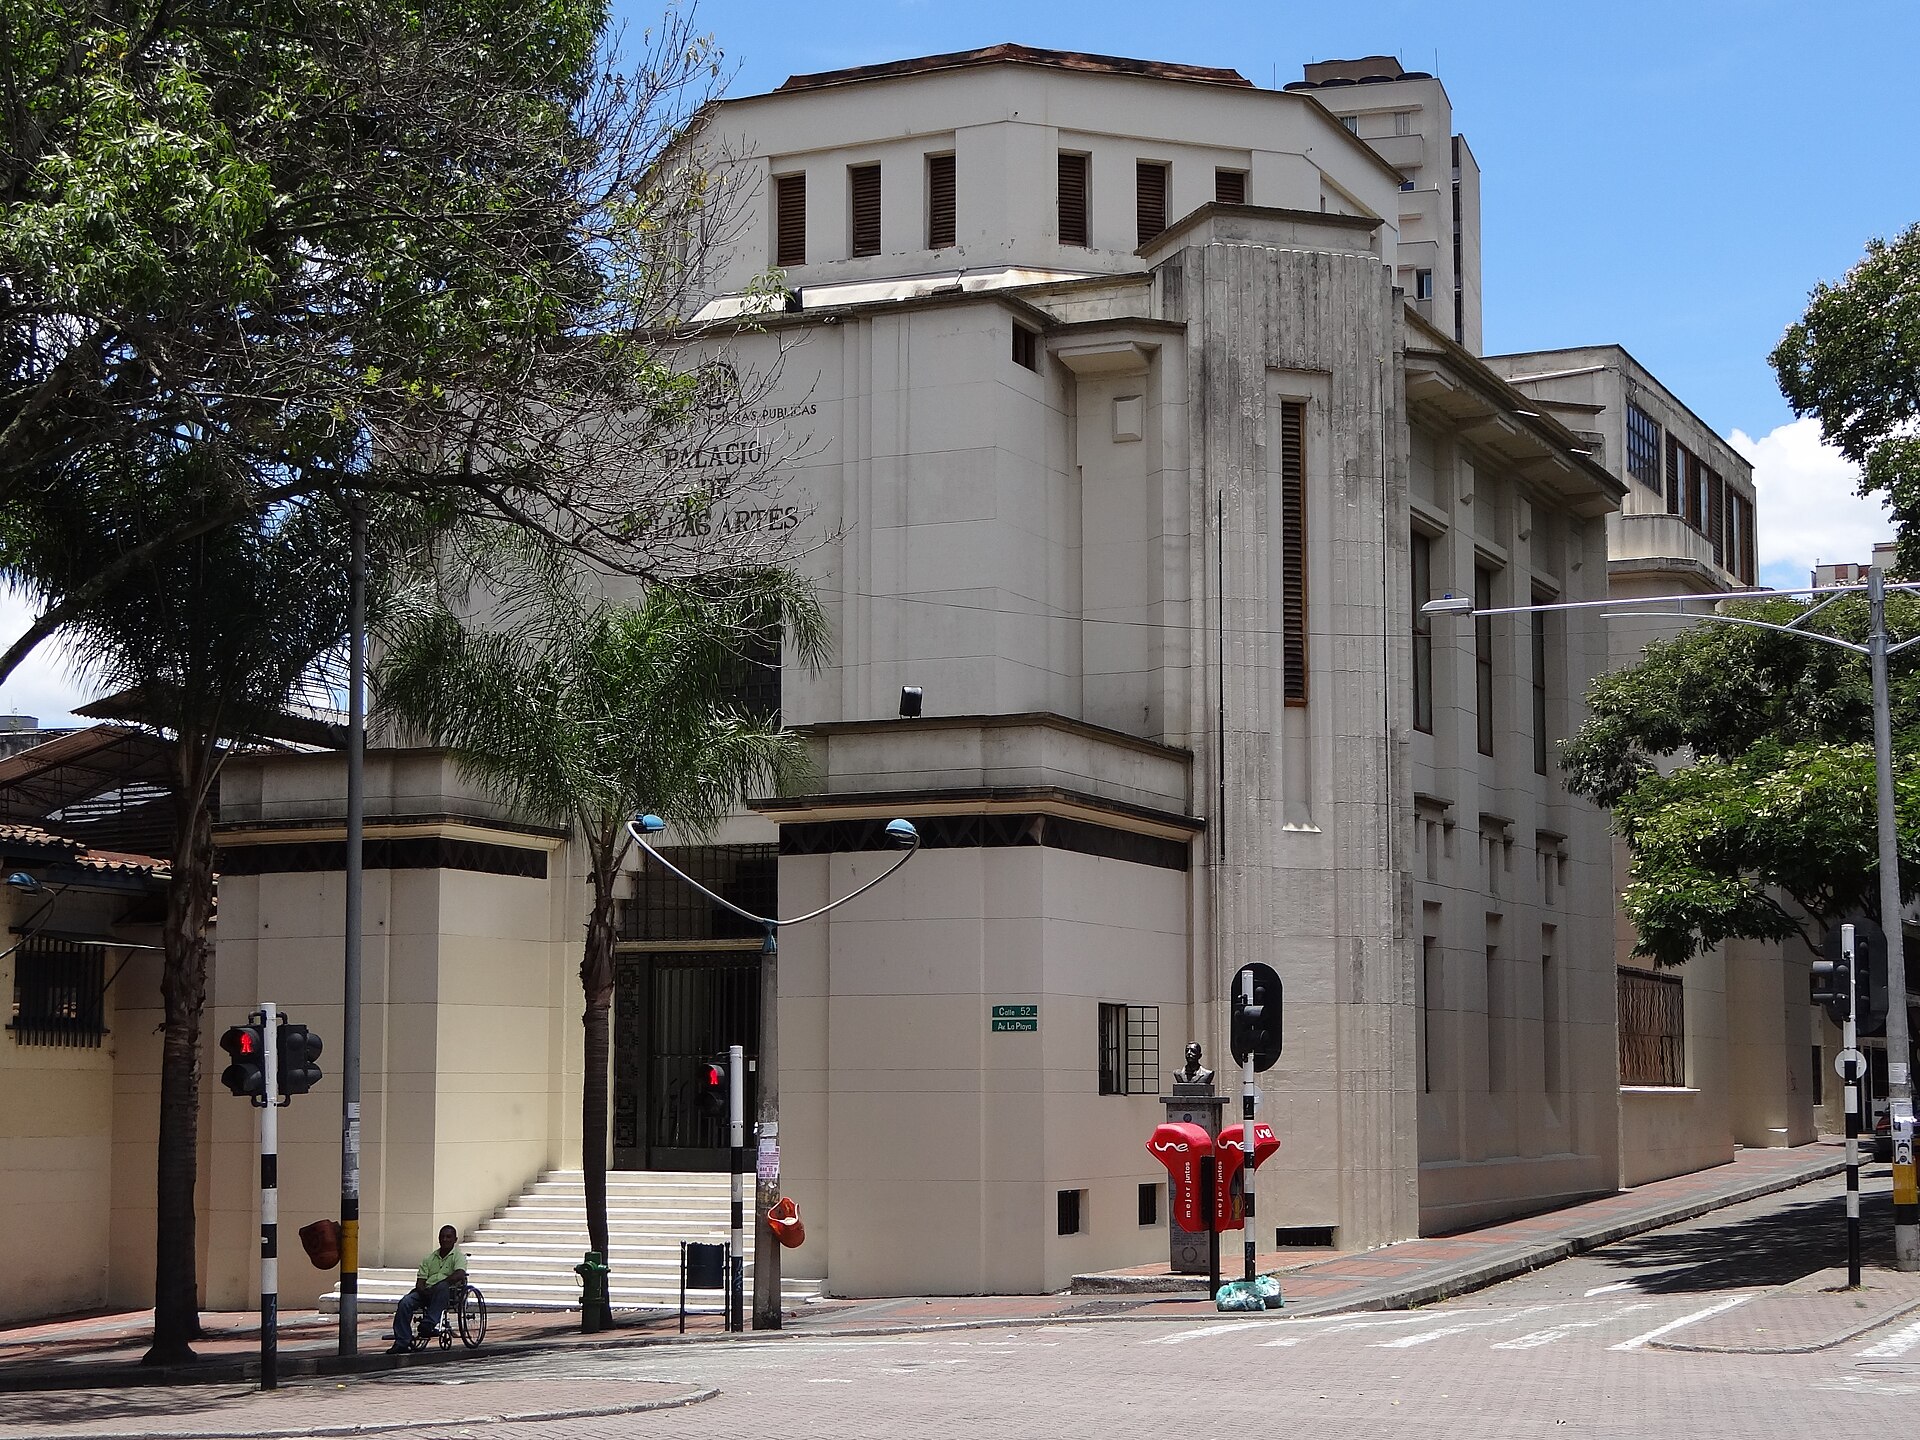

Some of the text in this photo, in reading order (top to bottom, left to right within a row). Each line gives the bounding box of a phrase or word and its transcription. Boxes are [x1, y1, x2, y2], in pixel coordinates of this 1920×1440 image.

[762, 403, 817, 420] PUBLICAS
[664, 440, 762, 469] PALACIO
[717, 506, 799, 535] ARTES
[998, 1007, 1031, 1016] Calle 52
[1154, 1141, 1189, 1152] une
[1184, 1161, 1192, 1218] mejor juntos
